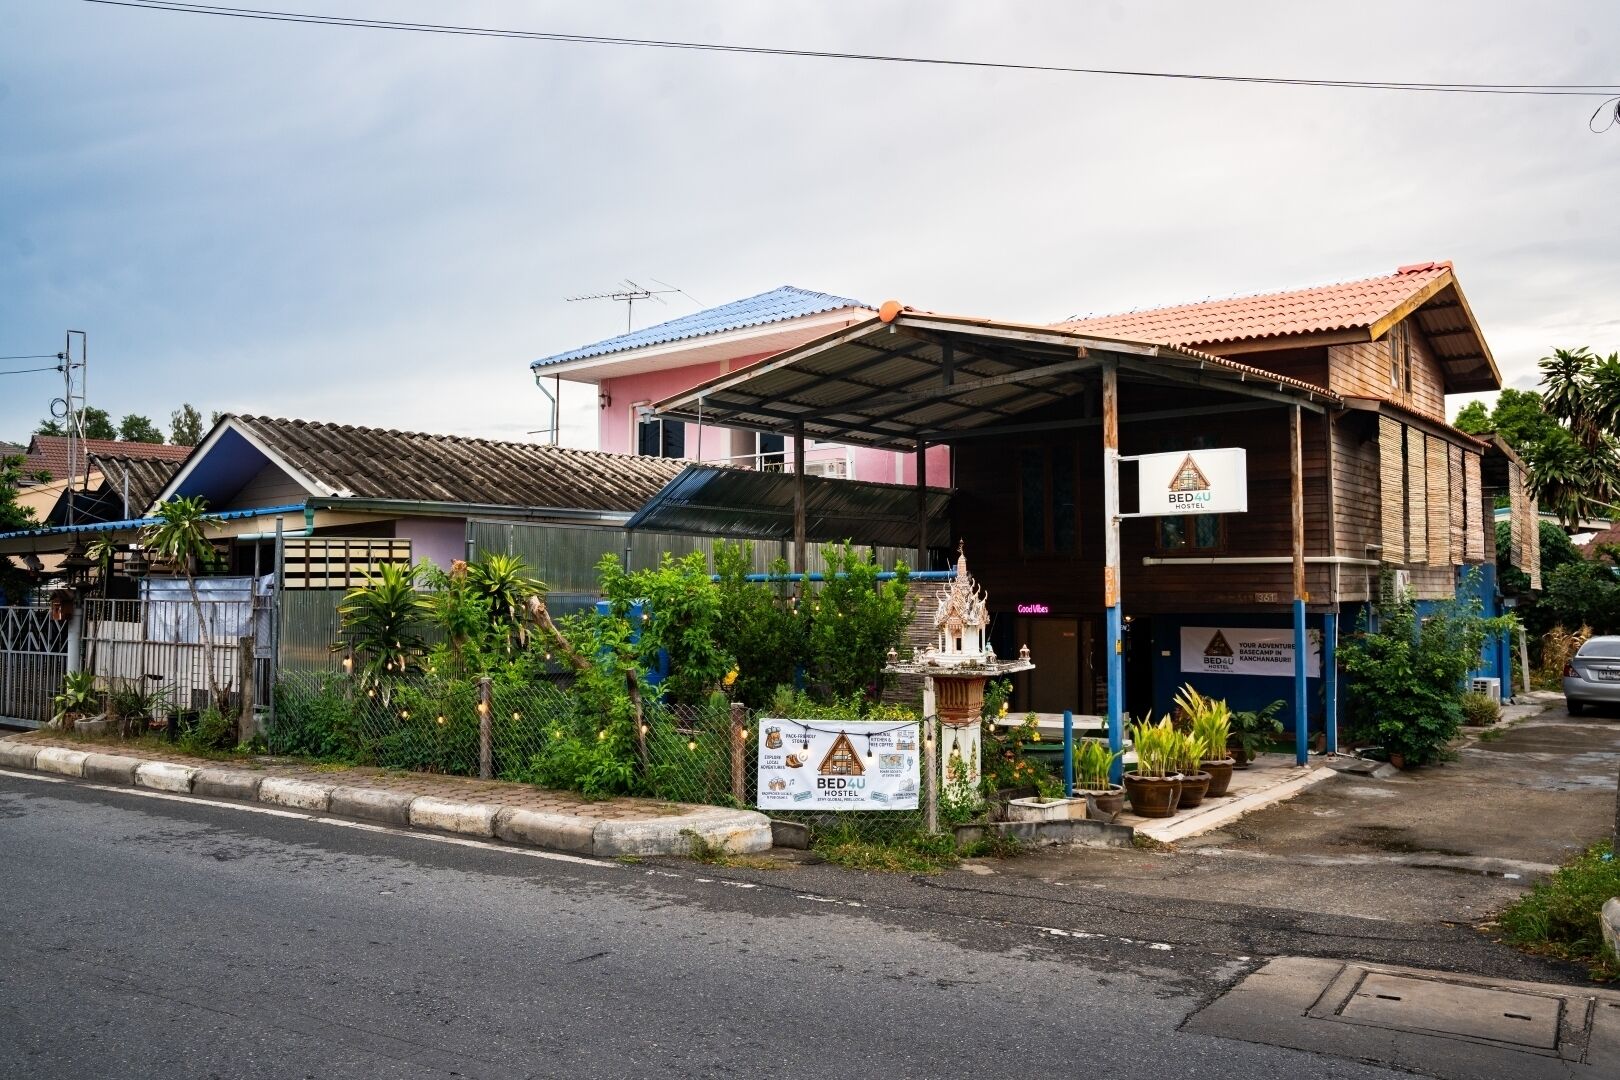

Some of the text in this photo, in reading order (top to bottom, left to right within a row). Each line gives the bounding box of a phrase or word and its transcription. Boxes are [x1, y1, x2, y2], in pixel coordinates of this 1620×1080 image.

[1168, 492, 1211, 503] BED4U
[1017, 604, 1049, 613] Good Vibes
[1203, 657, 1234, 665] BED4U
[816, 778, 866, 789] BED4U
